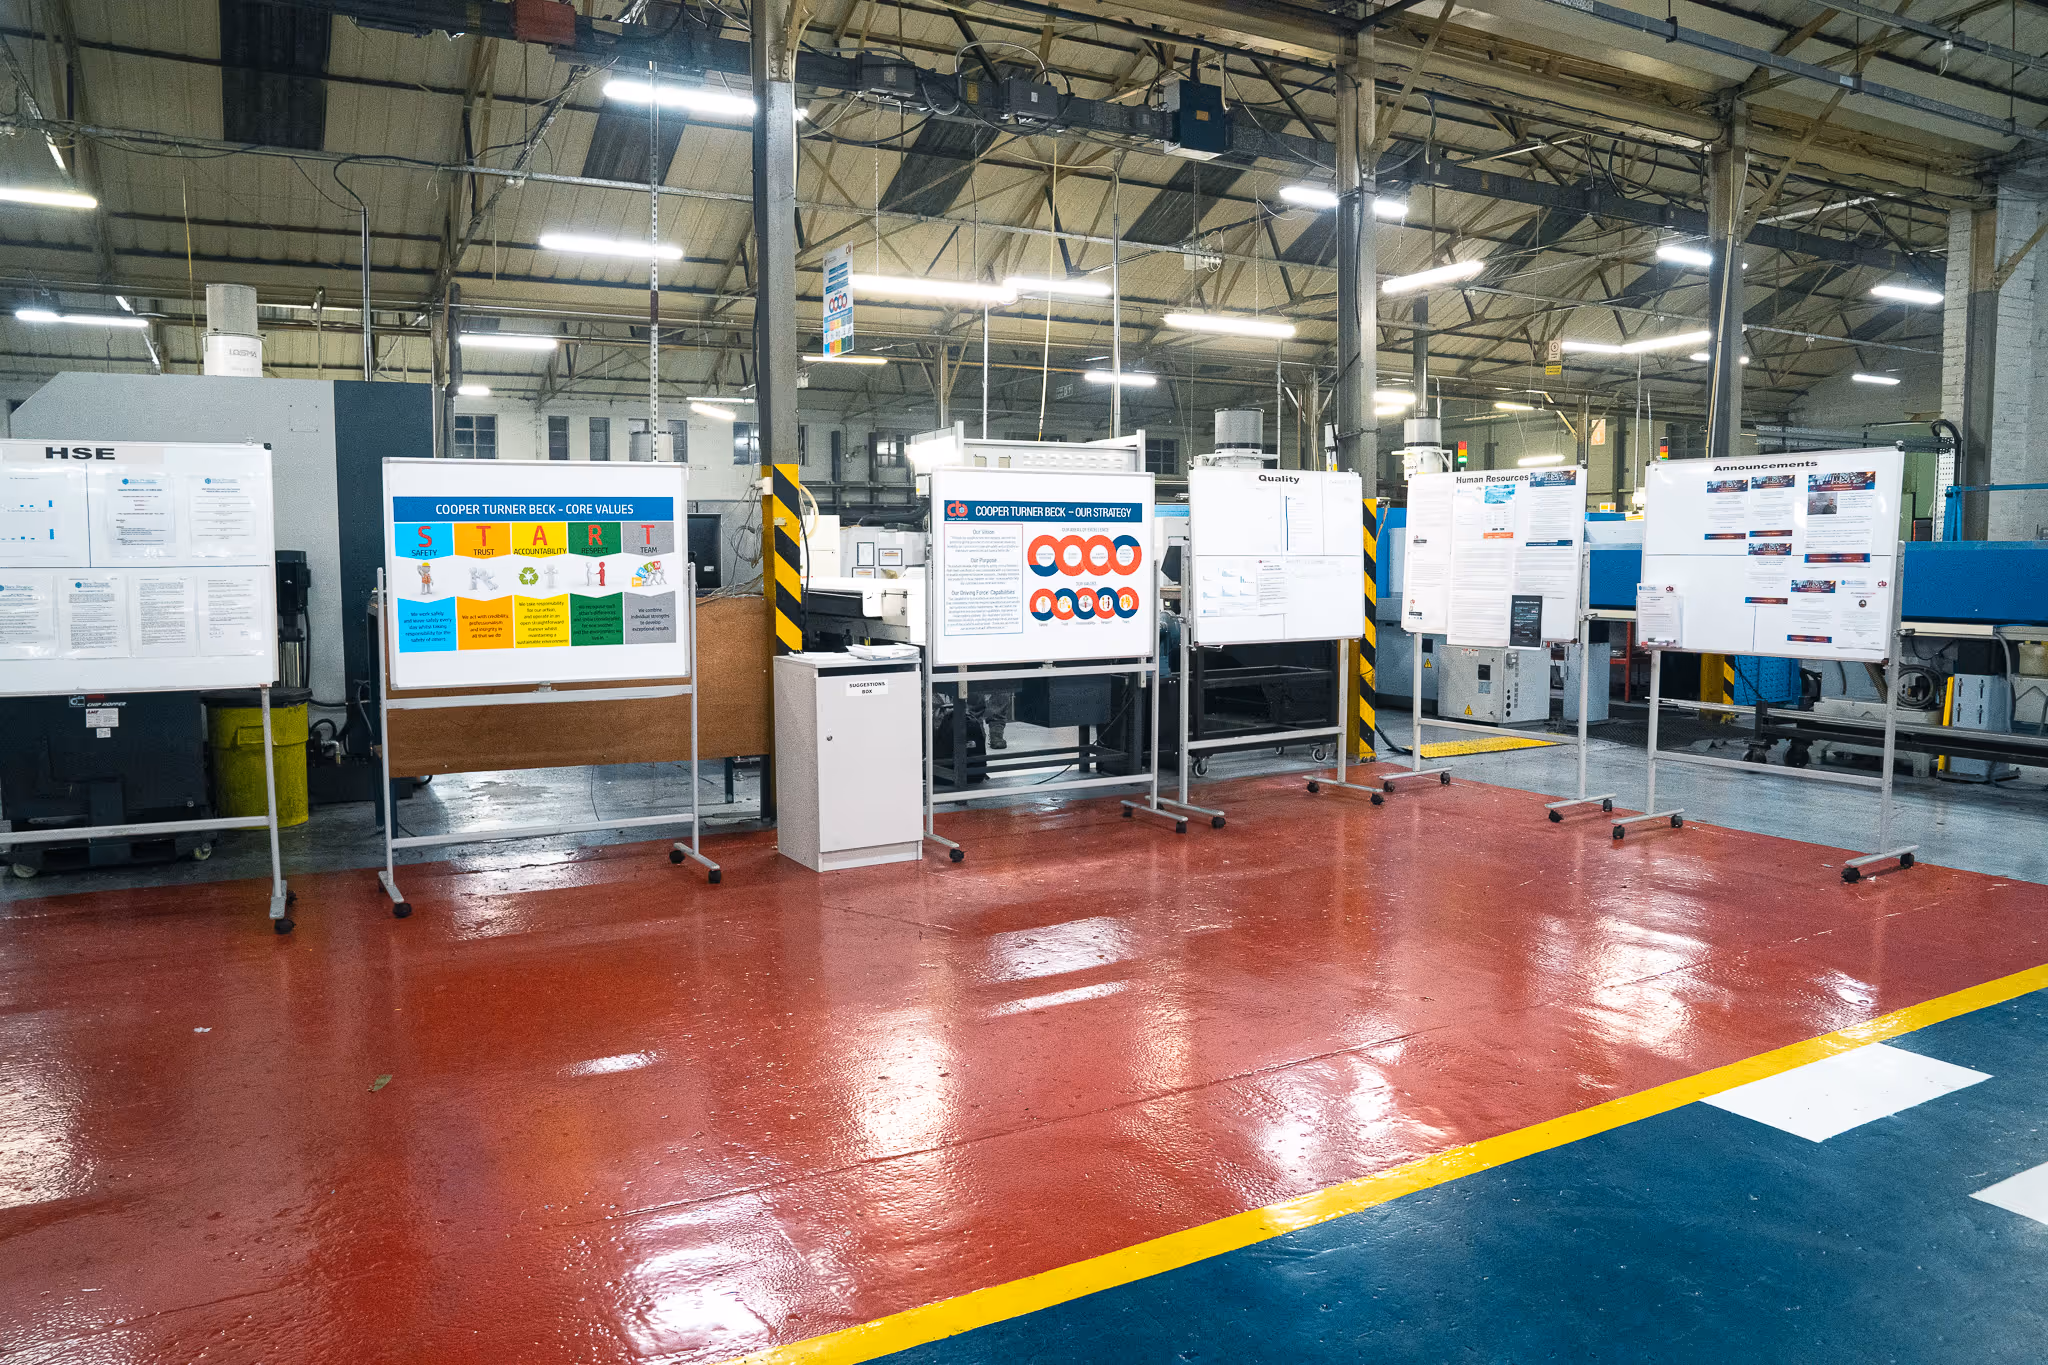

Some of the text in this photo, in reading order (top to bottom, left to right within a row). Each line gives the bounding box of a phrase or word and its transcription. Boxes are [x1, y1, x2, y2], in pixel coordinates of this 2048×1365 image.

[230, 349, 257, 358] LOSMA
[46, 447, 116, 460] HSE
[1714, 460, 1818, 472] Announcements
[1258, 474, 1300, 484] Quality
[1486, 474, 1529, 482] Resources
[436, 504, 480, 515] COOPER
[482, 504, 527, 515] TURNER
[529, 504, 556, 515] BECK
[566, 504, 592, 514] CORE
[595, 504, 634, 514] VALUES
[976, 506, 1009, 517] COOPER
[1010, 506, 1044, 517] TURNER
[1045, 507, 1066, 517] BECK
[1076, 507, 1094, 518] OUR
[1095, 508, 1132, 518] STRATEGY
[418, 524, 655, 547] S T A R T
[513, 547, 567, 556] ACCOUNTABILITY
